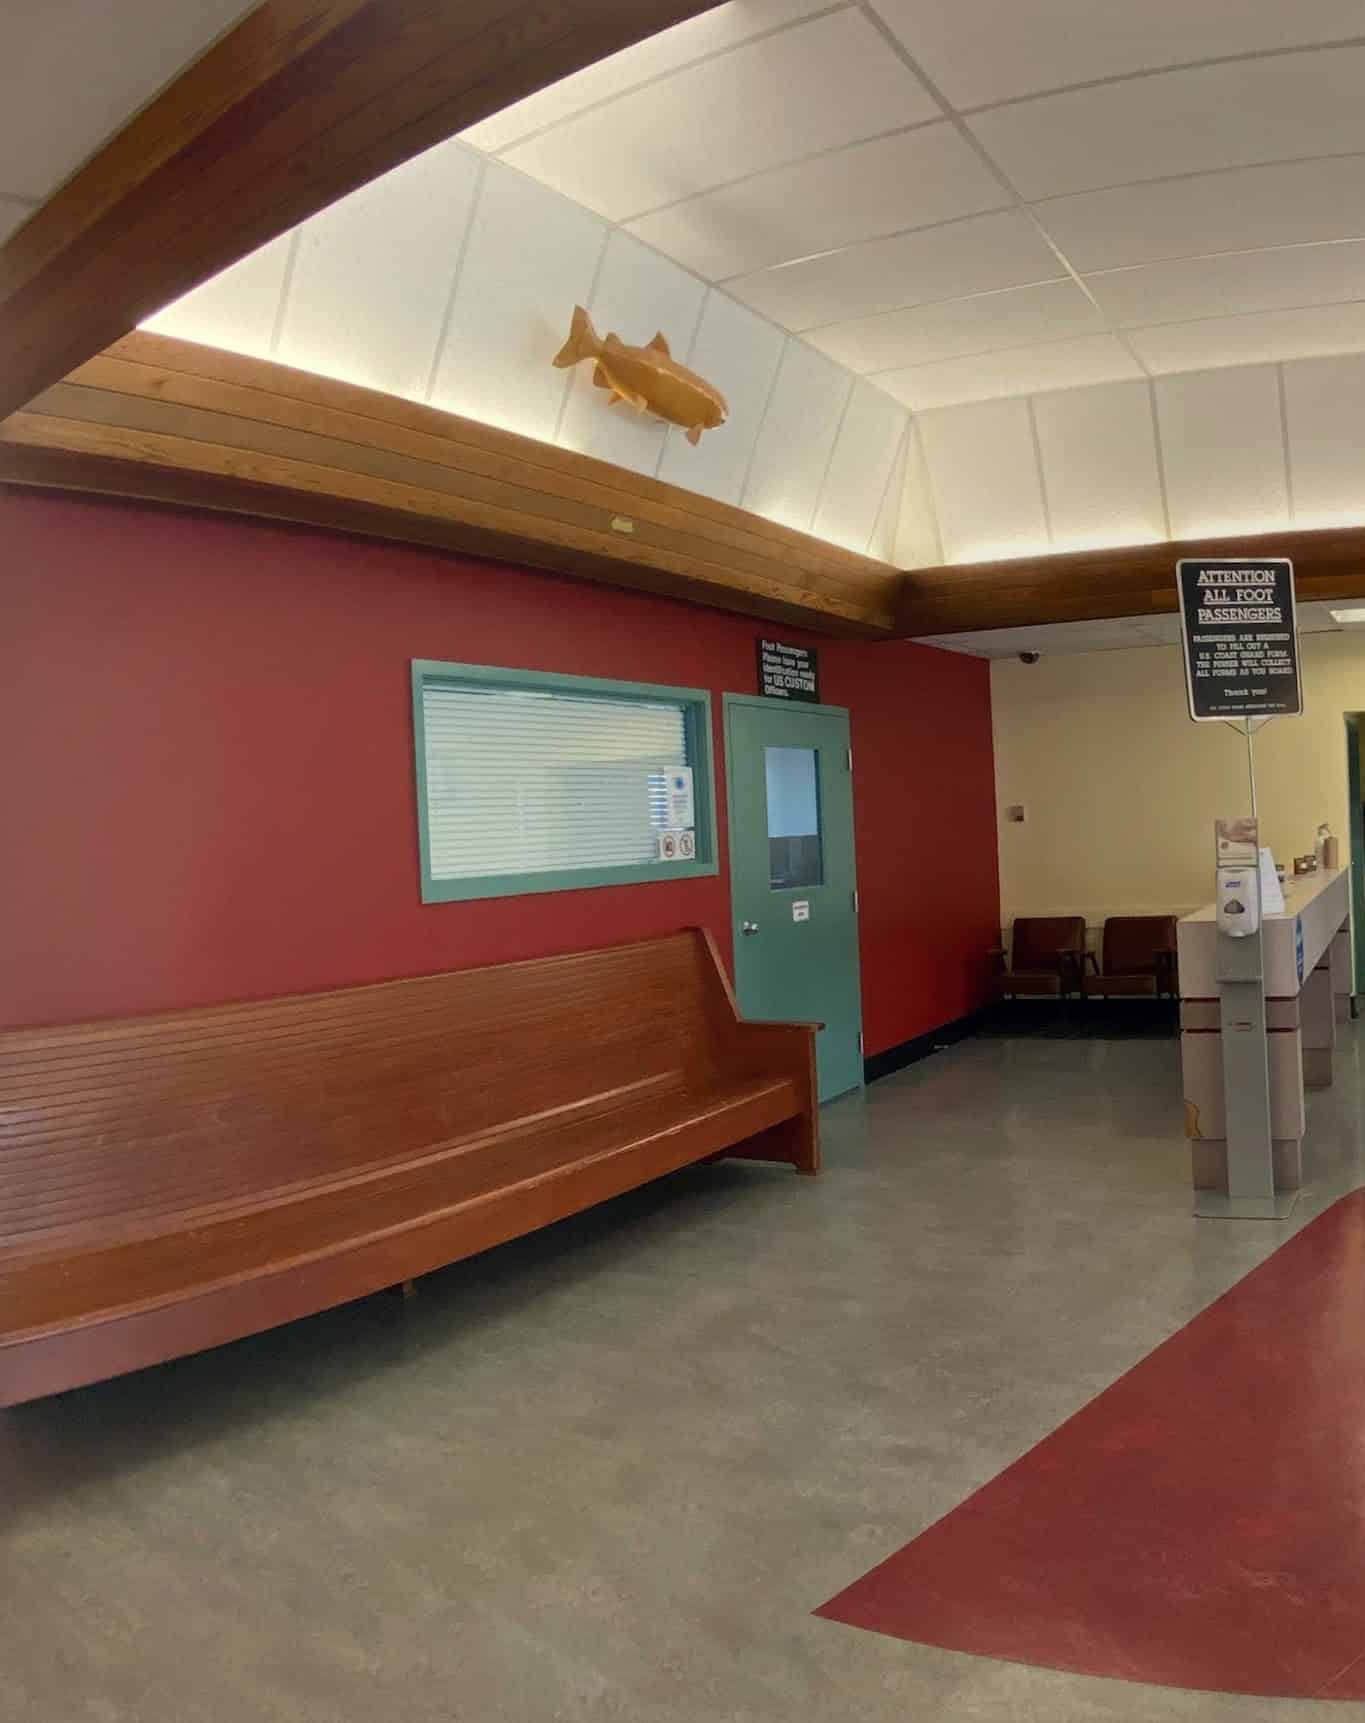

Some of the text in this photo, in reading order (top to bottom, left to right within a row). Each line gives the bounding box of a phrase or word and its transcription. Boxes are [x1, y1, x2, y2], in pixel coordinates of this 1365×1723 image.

[1198, 569, 1275, 583] ATTENTION
[1204, 588, 1273, 601] ALL FOOT
[1198, 607, 1282, 621] PASSENGERS
